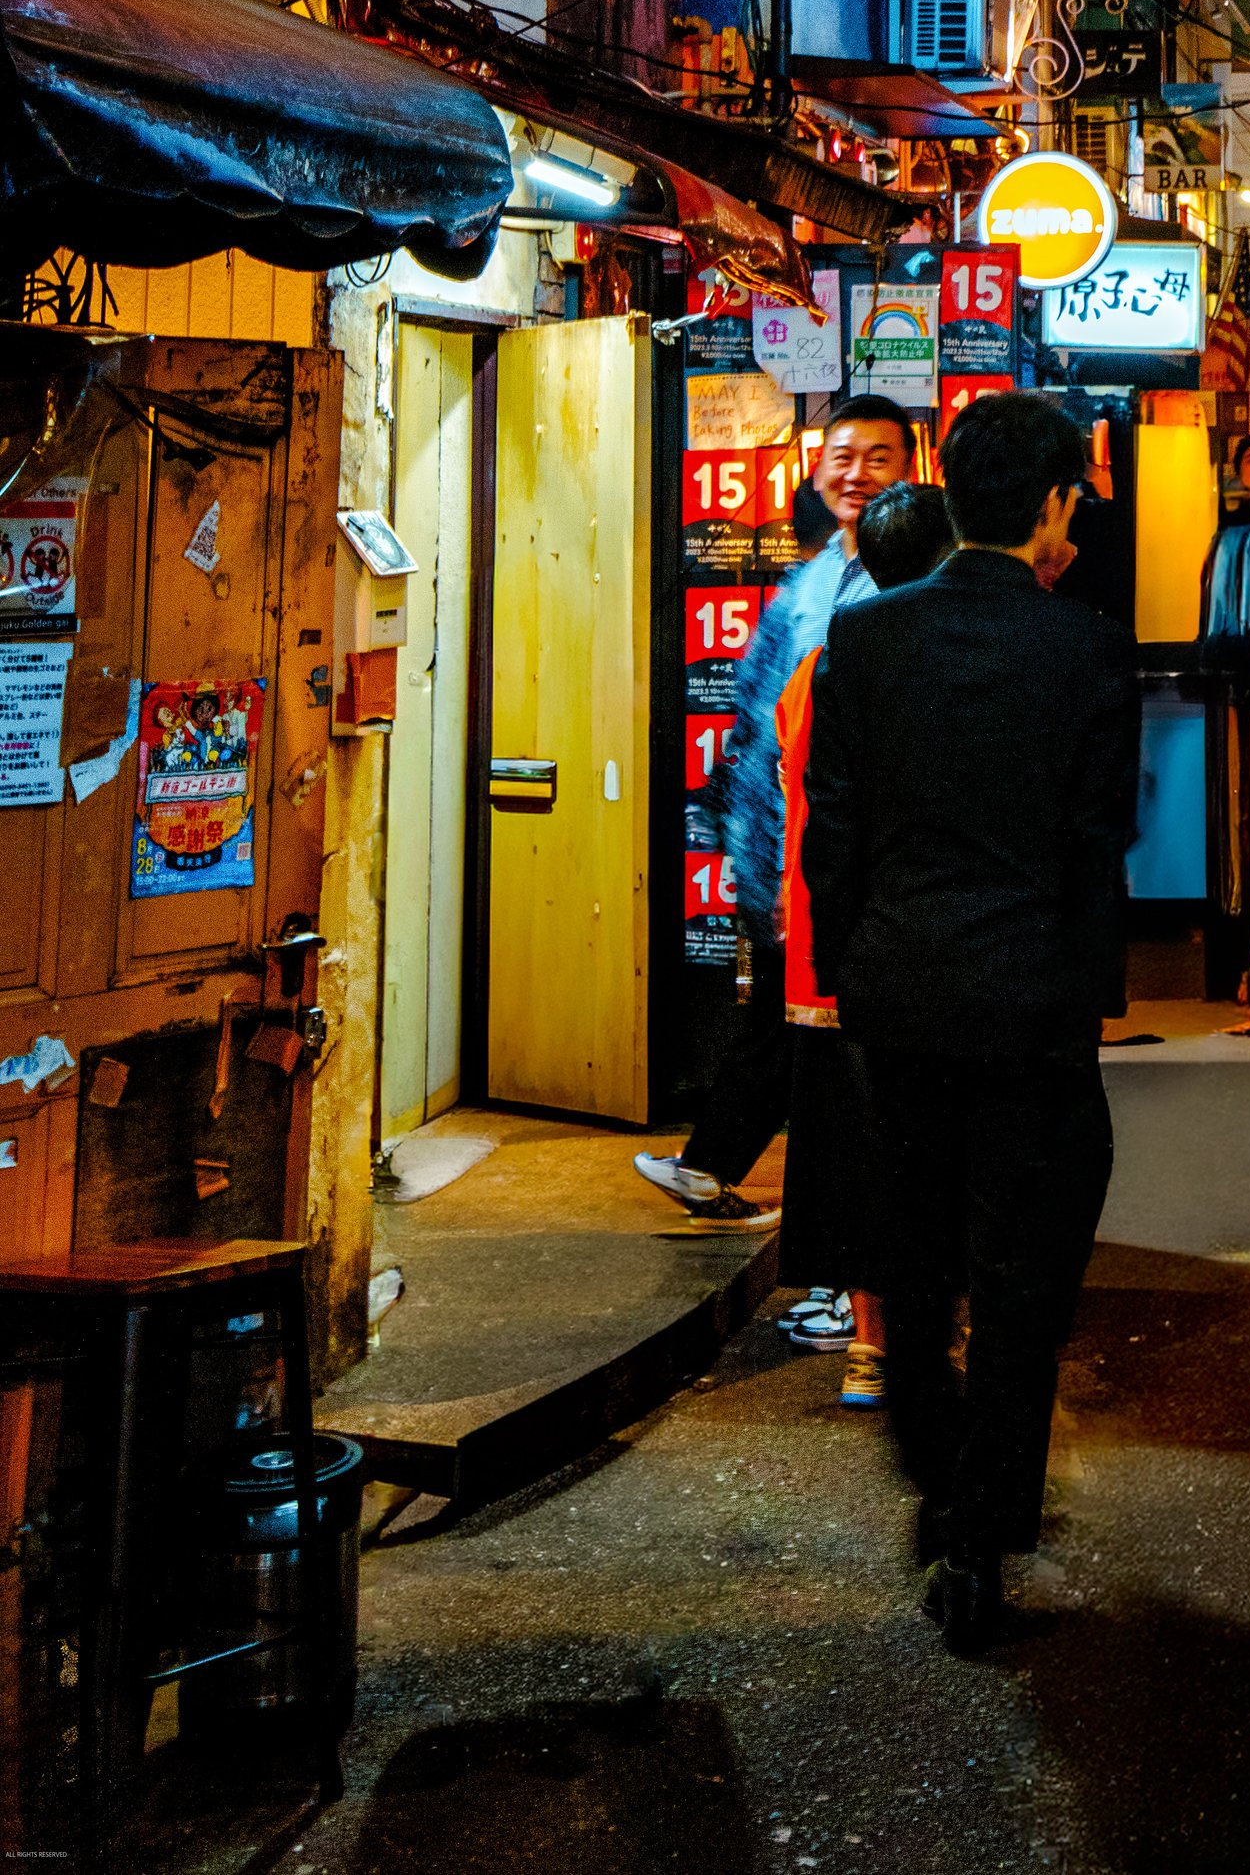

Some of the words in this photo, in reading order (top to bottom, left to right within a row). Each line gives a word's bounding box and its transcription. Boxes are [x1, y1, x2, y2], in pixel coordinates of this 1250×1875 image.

[1158, 168, 1208, 190] BAR
[952, 264, 1003, 312] 15
[710, 335, 753, 343] Anniversar
[943, 338, 960, 347] 15th
[962, 338, 1009, 350] Anniversary
[796, 338, 826, 360] 82
[698, 384, 740, 402] MAY
[693, 405, 735, 421] Before
[693, 462, 747, 510] 15
[767, 462, 801, 510] 1
[30, 523, 64, 539] Drink
[686, 539, 704, 547] 15th
[760, 539, 778, 547] 15th
[21, 619, 53, 629] Golden
[696, 600, 750, 650] 15
[689, 678, 707, 687] 15th
[160, 776, 238, 794] 新宿ゴールデン街
[167, 820, 225, 852] 感謝祭
